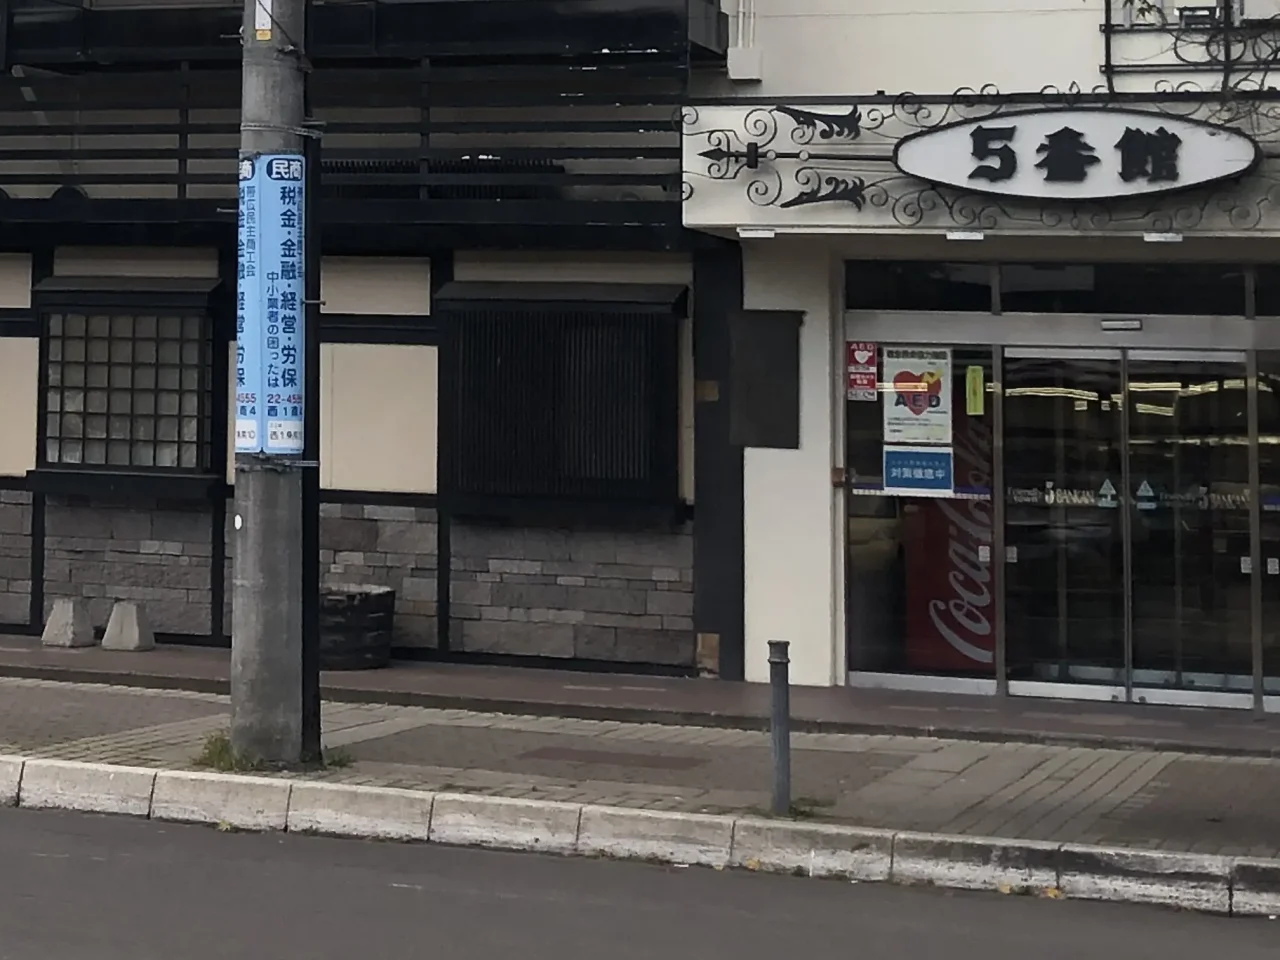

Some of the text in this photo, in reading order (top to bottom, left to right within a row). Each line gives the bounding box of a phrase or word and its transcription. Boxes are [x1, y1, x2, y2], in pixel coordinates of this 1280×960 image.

[967, 125, 1183, 183] 5番館
[271, 159, 303, 180] 民商
[894, 394, 941, 408] AED
